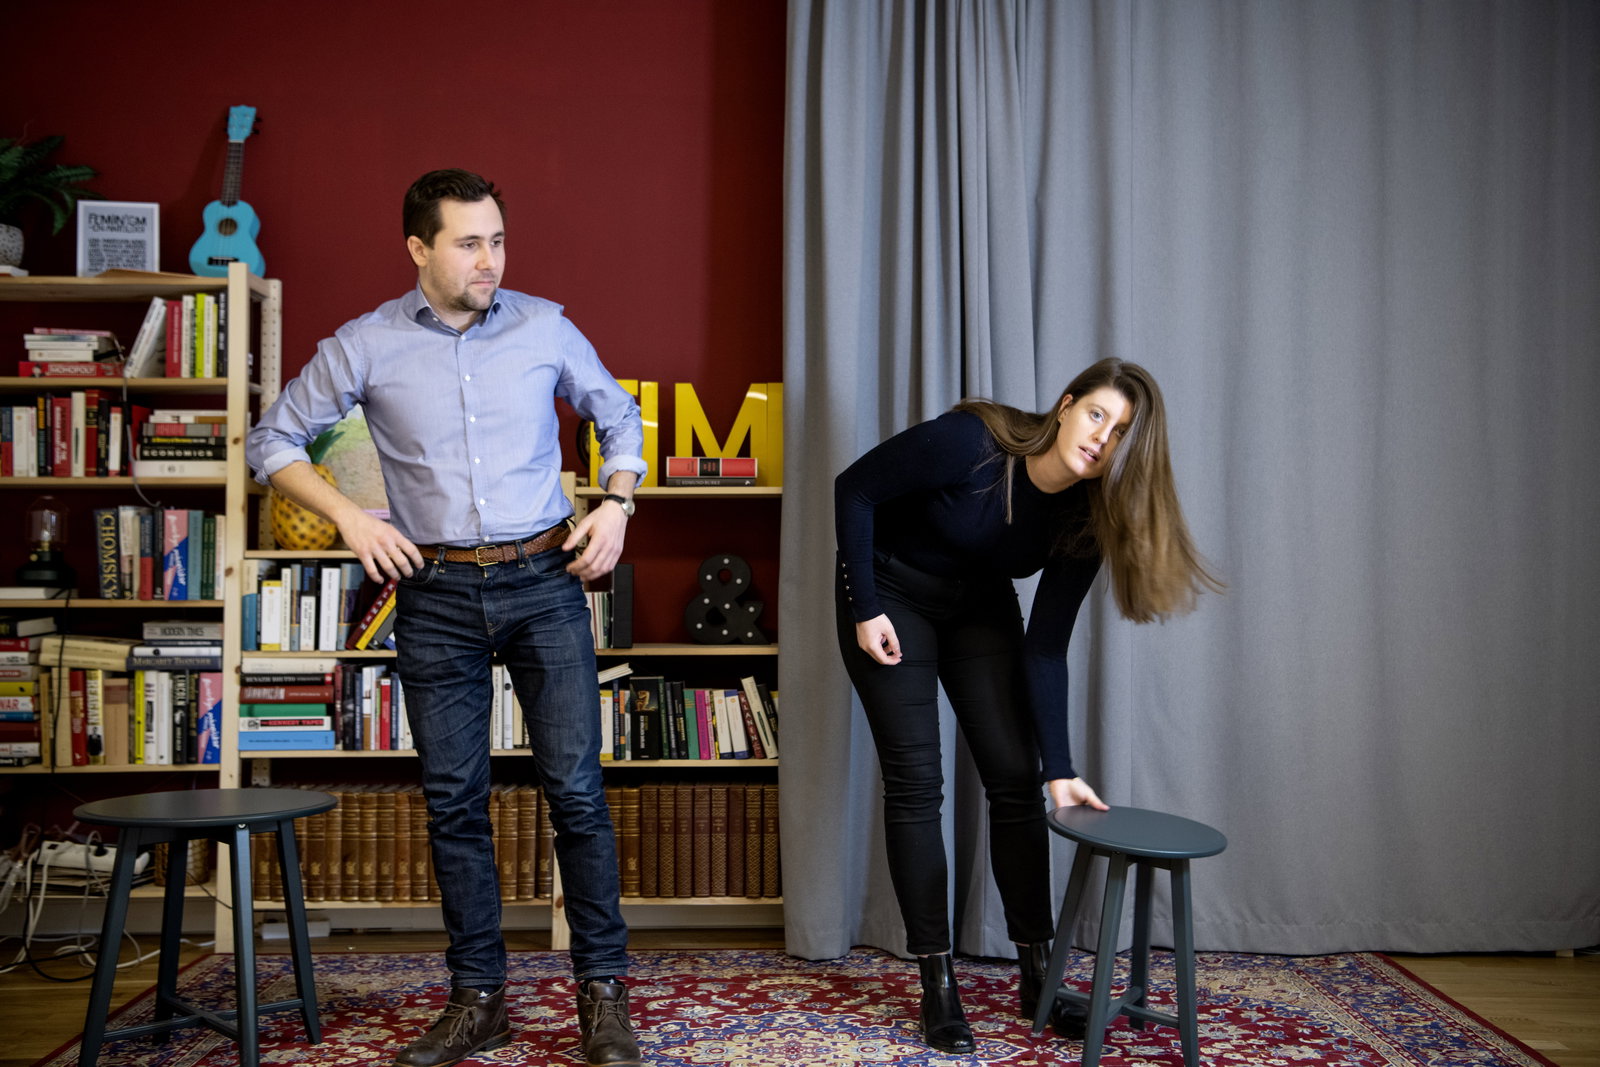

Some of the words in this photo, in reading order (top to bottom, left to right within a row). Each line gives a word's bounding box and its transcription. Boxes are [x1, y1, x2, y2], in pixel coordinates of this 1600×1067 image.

[49, 365, 96, 375] MONOPOLY
[142, 449, 214, 457] ECONOMICS
[100, 514, 118, 599] CHOMSKY
[86, 680, 98, 723] REAGAN
[175, 674, 186, 706] LINCOLN
